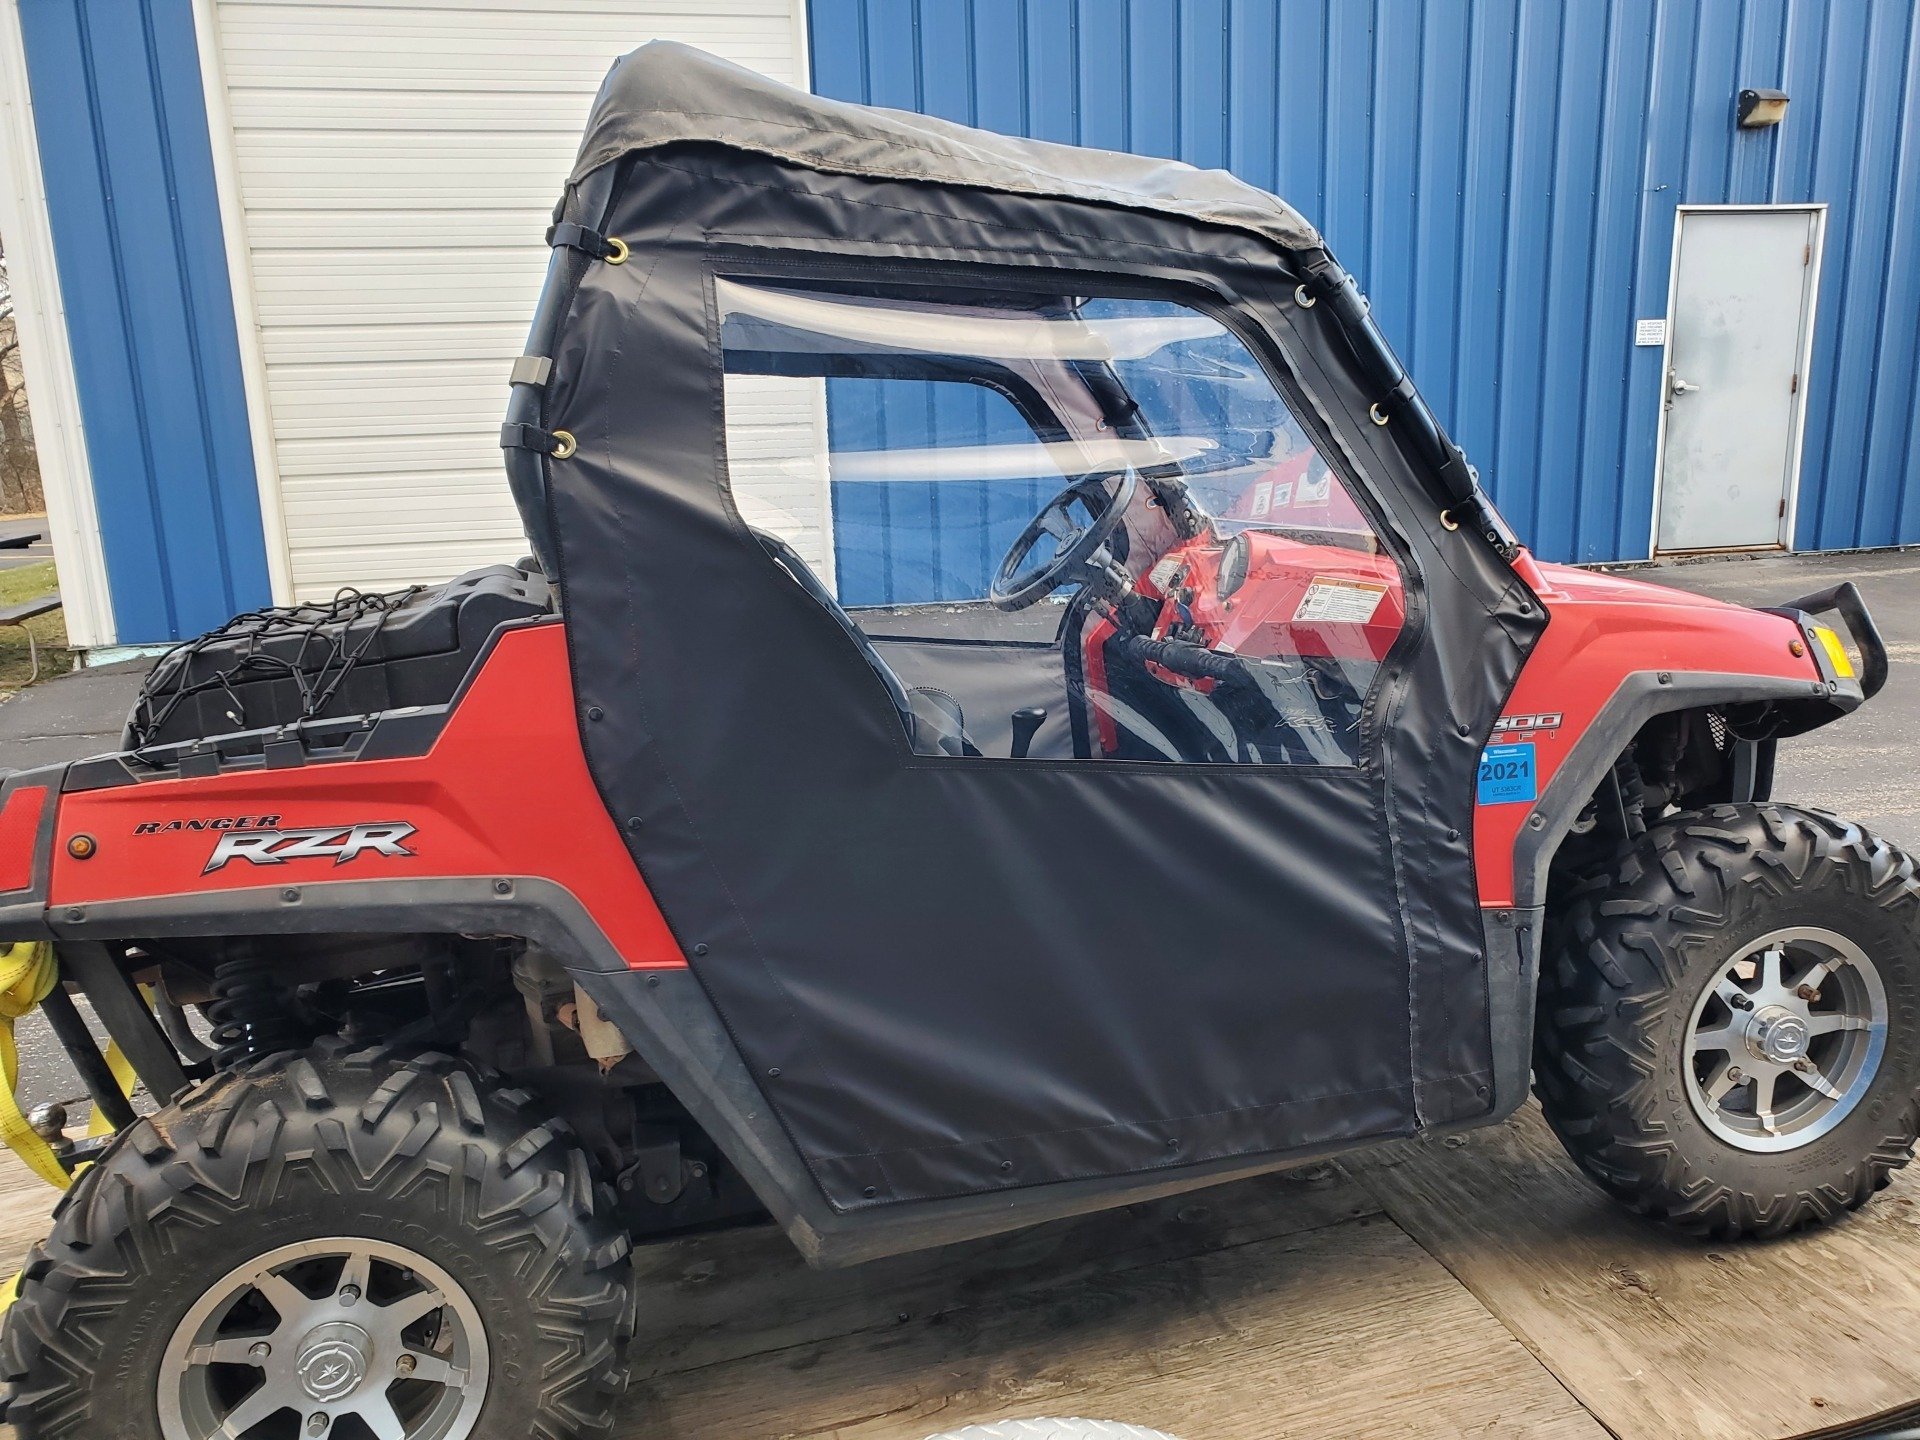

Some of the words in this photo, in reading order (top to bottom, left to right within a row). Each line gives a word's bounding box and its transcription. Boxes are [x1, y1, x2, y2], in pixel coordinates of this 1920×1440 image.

[1480, 761, 1529, 781] 2021
[132, 814, 283, 836] RANGER
[200, 820, 418, 877] RZR
